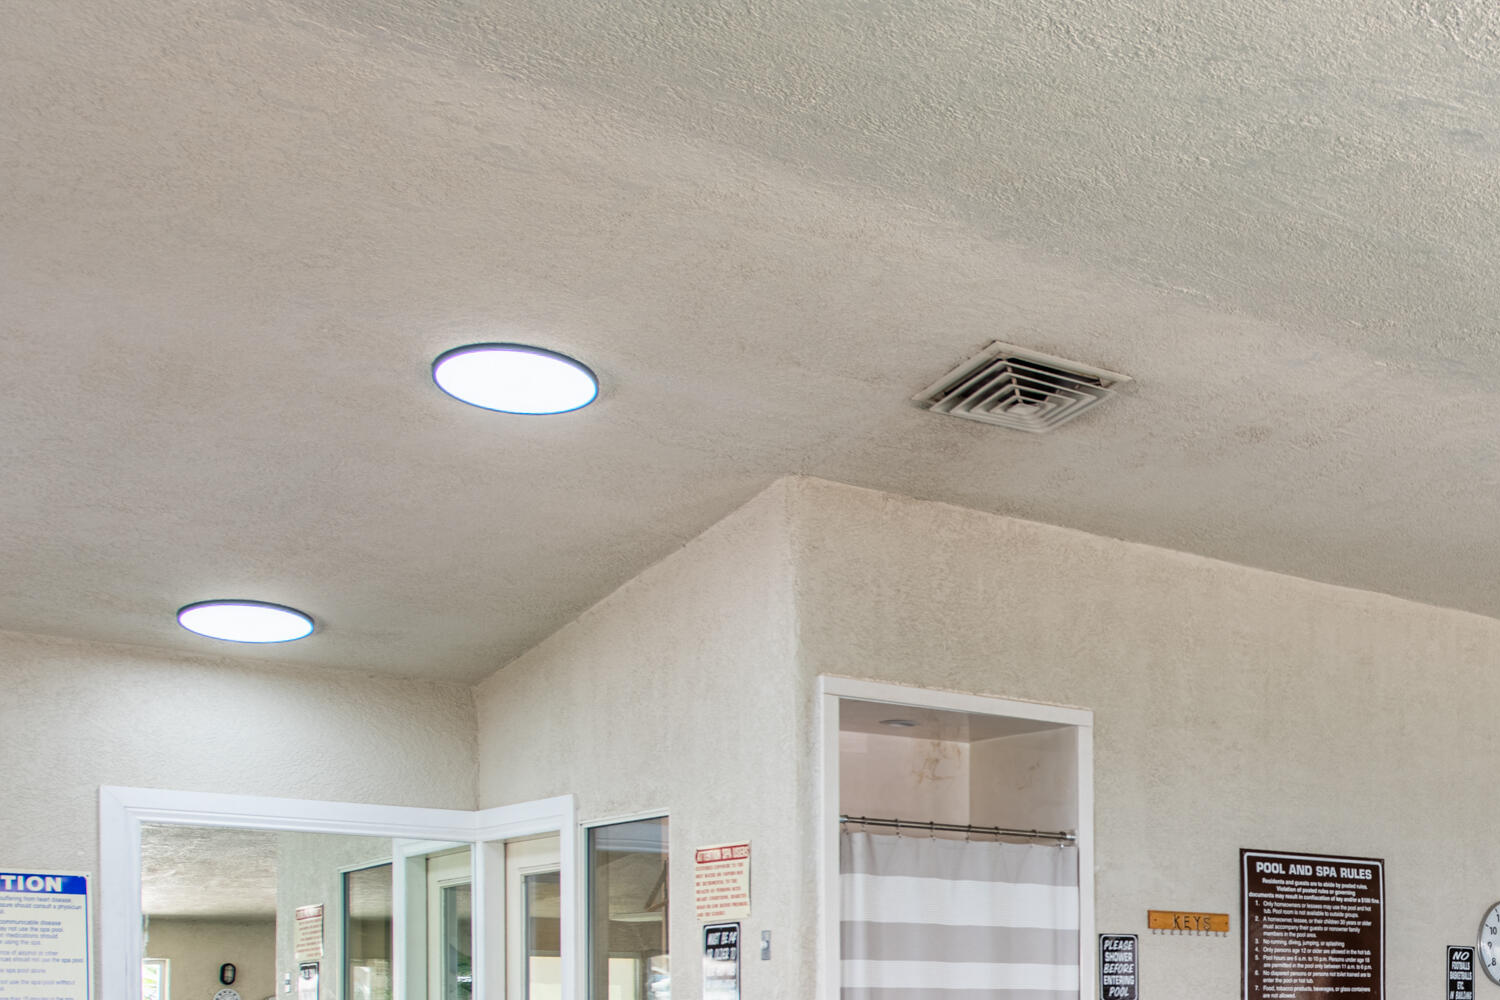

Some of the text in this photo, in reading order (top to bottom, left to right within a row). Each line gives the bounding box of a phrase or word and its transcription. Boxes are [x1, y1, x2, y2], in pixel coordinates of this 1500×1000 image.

[1256, 862, 1371, 879] POOL AND SPA RULES
[1, 875, 62, 891] TION
[1173, 914, 1212, 930] KEYS
[1489, 927, 1497, 935] 10
[1104, 940, 1134, 950] PLEASE
[1487, 941, 1492, 949] 9
[1105, 952, 1133, 962] SHOWER
[1453, 951, 1469, 960] NO
[1492, 958, 1496, 966] 8
[1104, 964, 1134, 974] BEFORE
[1103, 976, 1135, 985] ENTERING
[1109, 987, 1129, 997] POOL
